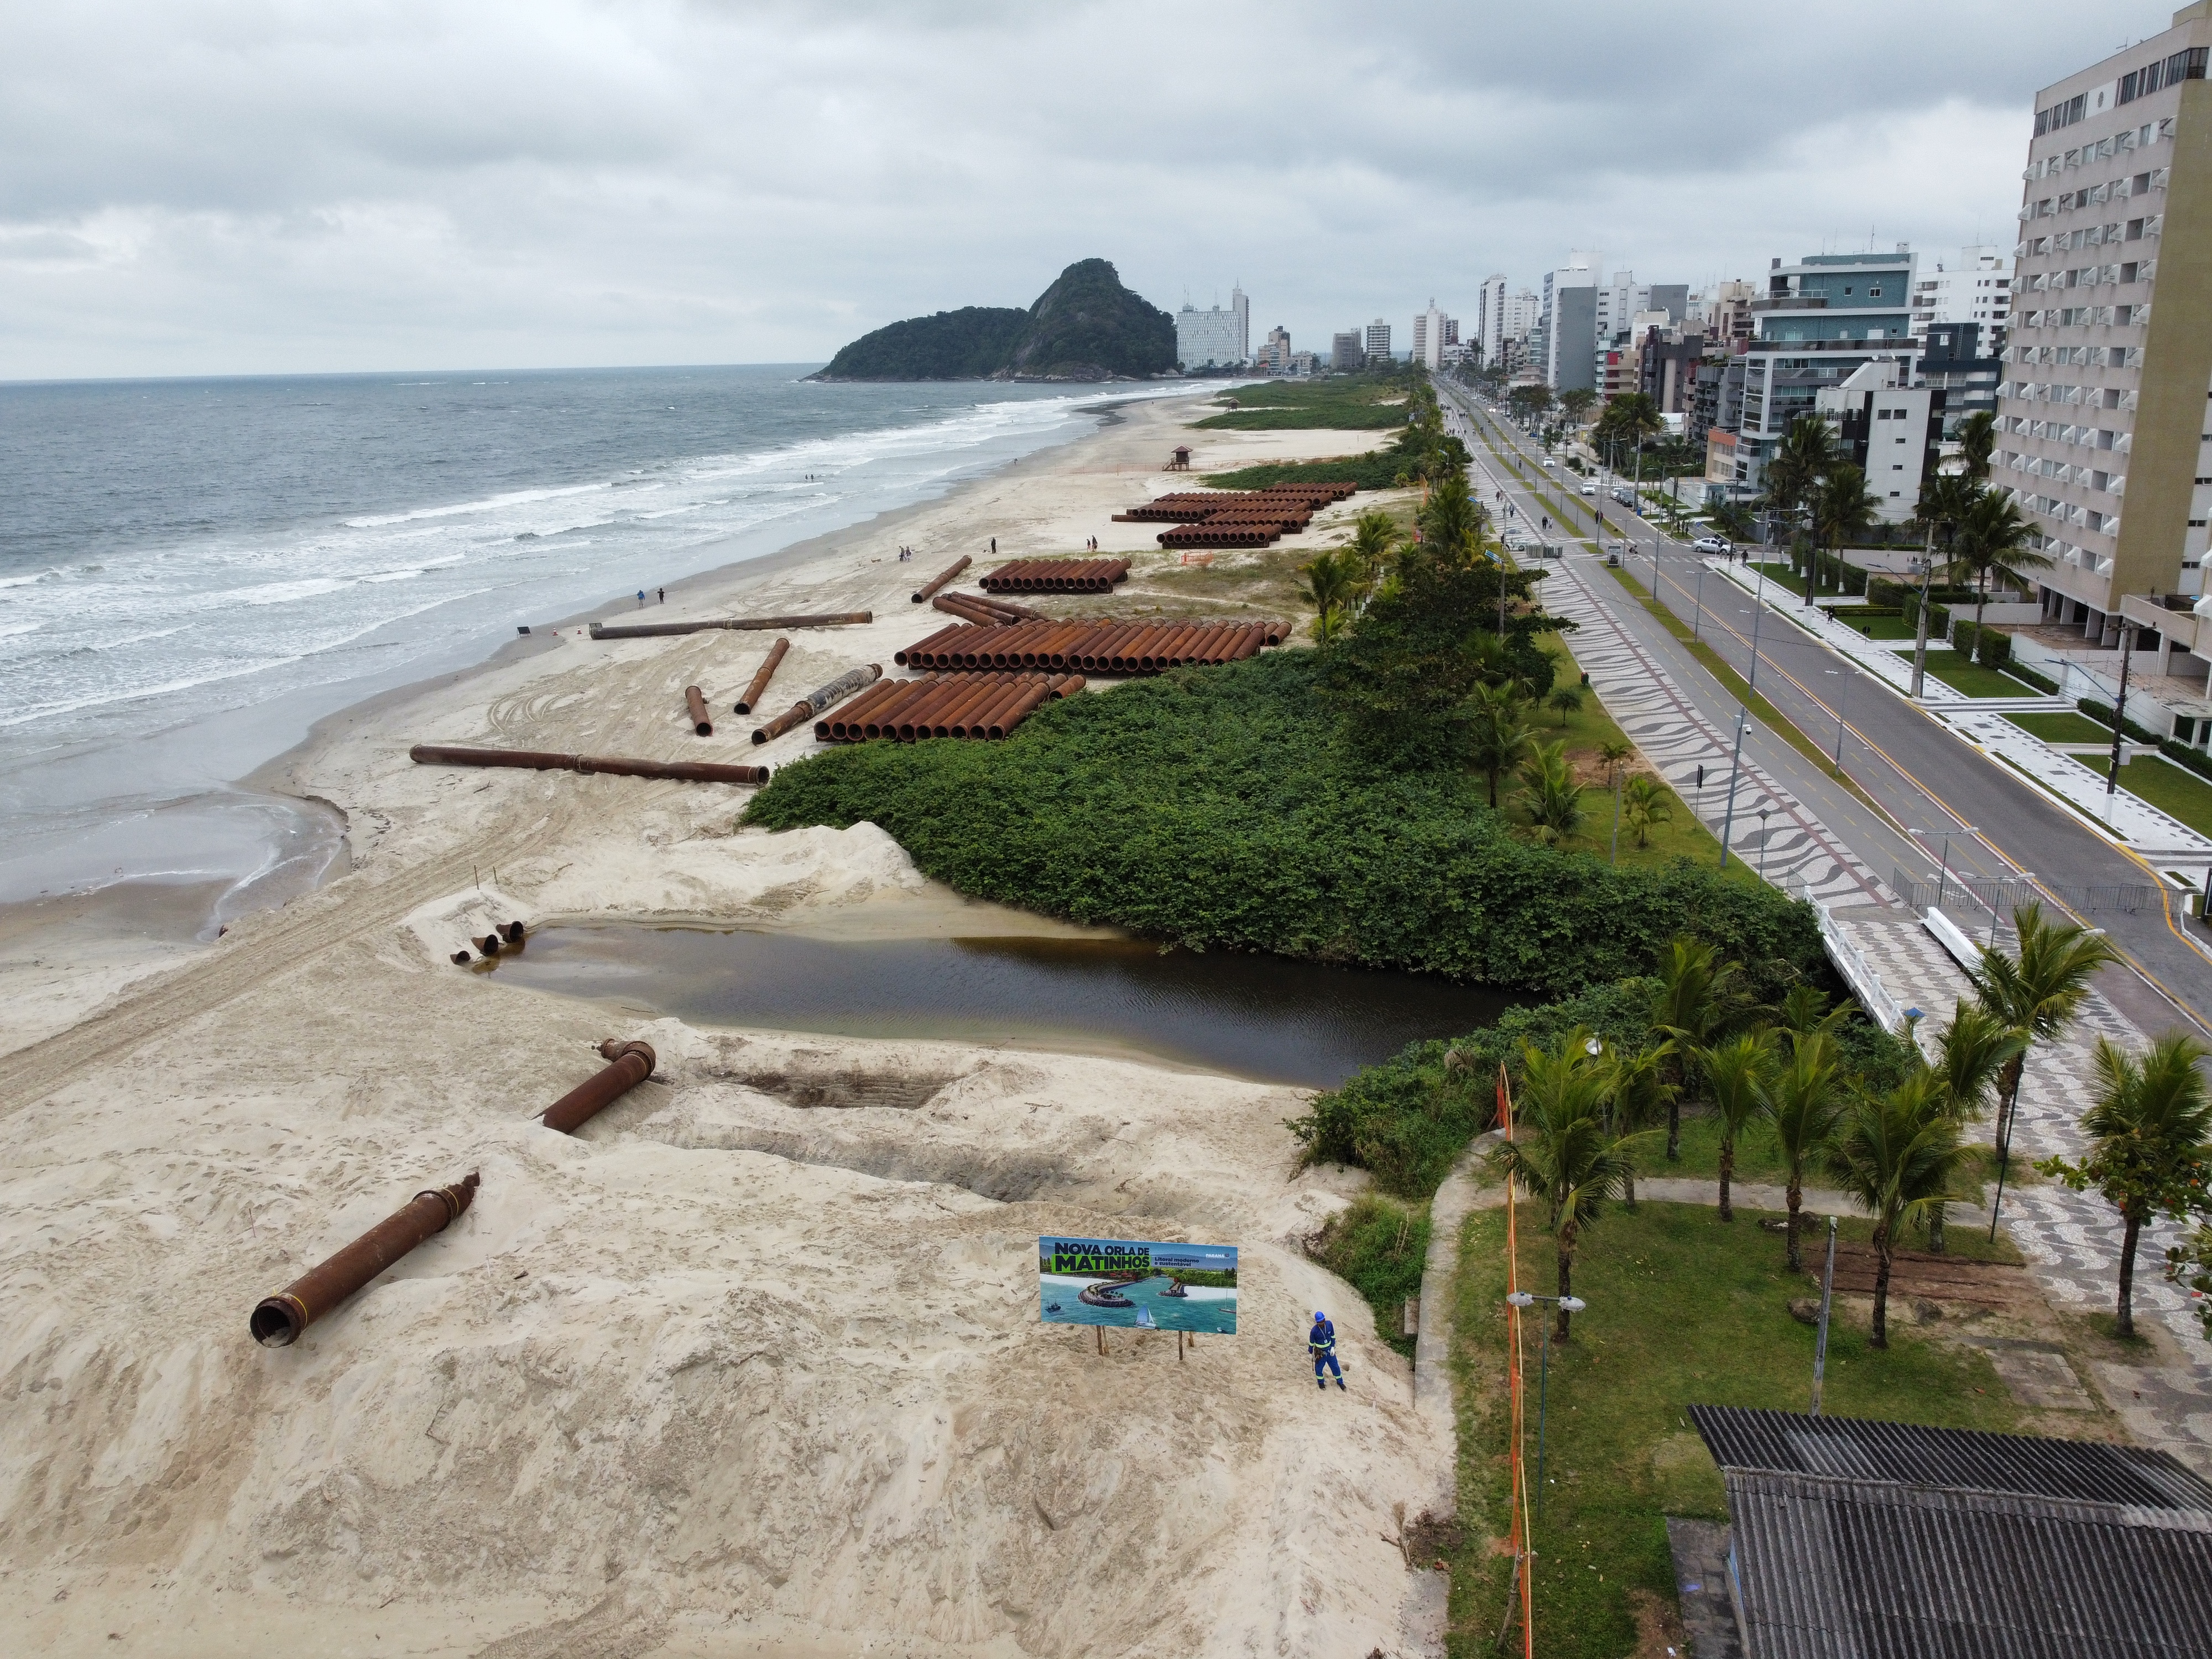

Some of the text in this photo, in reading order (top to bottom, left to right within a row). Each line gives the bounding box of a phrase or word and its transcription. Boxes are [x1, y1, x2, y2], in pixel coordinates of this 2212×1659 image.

[1055, 1242, 1150, 1255] NOVA ORLA DE
[1055, 1255, 1150, 1271] MATINHOS
